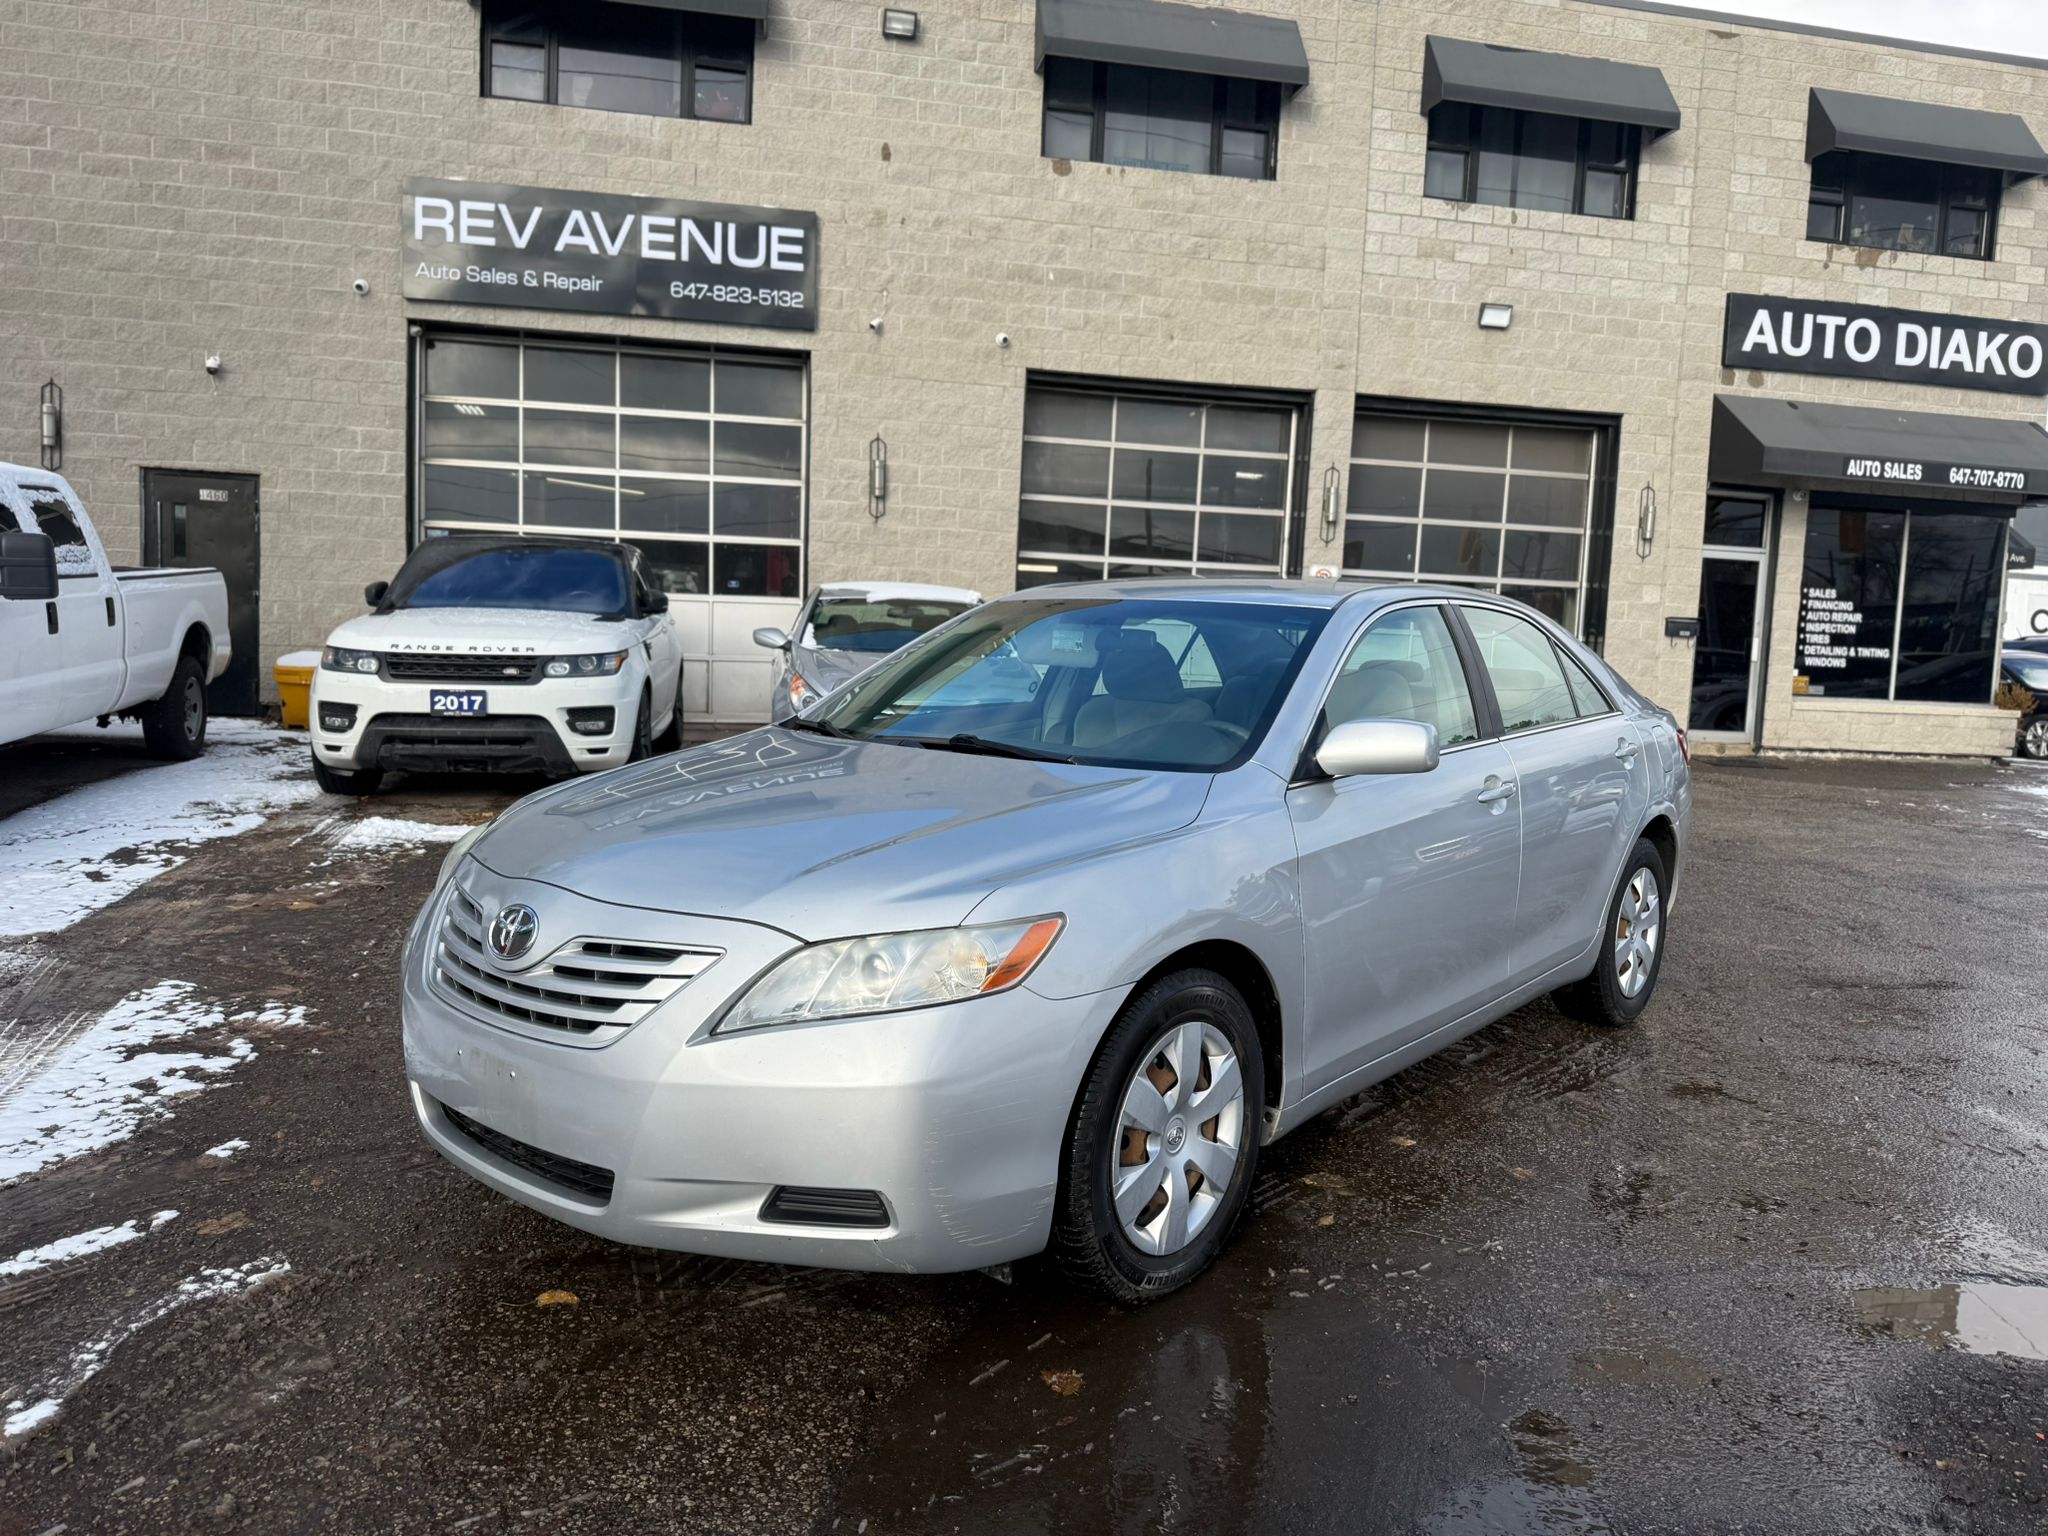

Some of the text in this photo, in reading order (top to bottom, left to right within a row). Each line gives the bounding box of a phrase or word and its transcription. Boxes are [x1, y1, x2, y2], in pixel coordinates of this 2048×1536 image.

[413, 196, 805, 272] REV AVENUE
[415, 261, 603, 293] Auto Sales & Repair
[670, 281, 804, 308] 647-823-5132
[1741, 308, 2043, 379] AUTO DIAKO
[1847, 458, 1922, 480] AUTO SALES
[1949, 466, 2025, 489] 647-707-8770
[1808, 588, 1837, 599] SALES
[1807, 600, 1854, 611] FINANCING
[1806, 611, 1863, 623] AUTO REPAIR
[1805, 622, 1856, 634] INSPECTION
[1805, 634, 1831, 645] TIRES
[390, 643, 535, 653] RANGE ROVER
[1804, 645, 1890, 658] DETAILING & TINTING
[1804, 656, 1847, 668] WINDOWS
[433, 695, 483, 710] 2017
